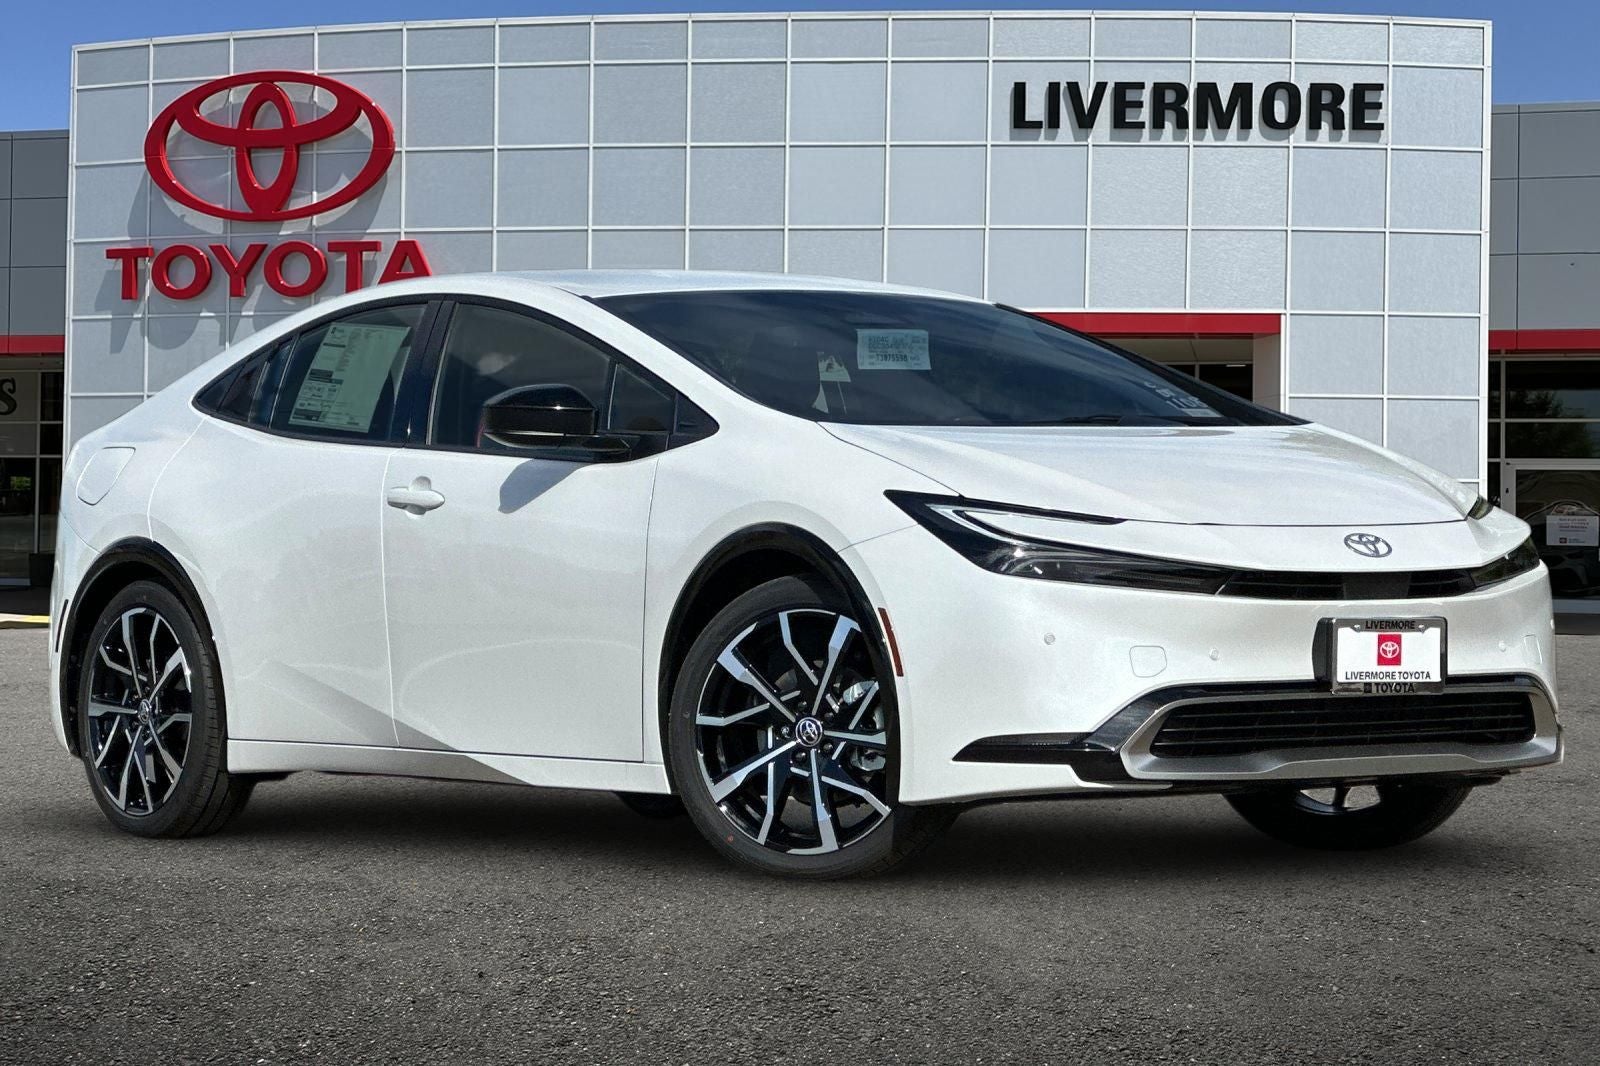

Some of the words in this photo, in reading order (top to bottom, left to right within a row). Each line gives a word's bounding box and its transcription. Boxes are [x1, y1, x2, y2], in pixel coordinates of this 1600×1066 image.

[1012, 81, 1385, 131] LIVERMORE
[106, 240, 433, 300] TOYOTA
[1365, 620, 1416, 630] LIVERMORE
[1345, 671, 1397, 681] LIVERMORE
[1398, 671, 1431, 680] TOYOTA
[1374, 682, 1415, 693] TOYOTA
